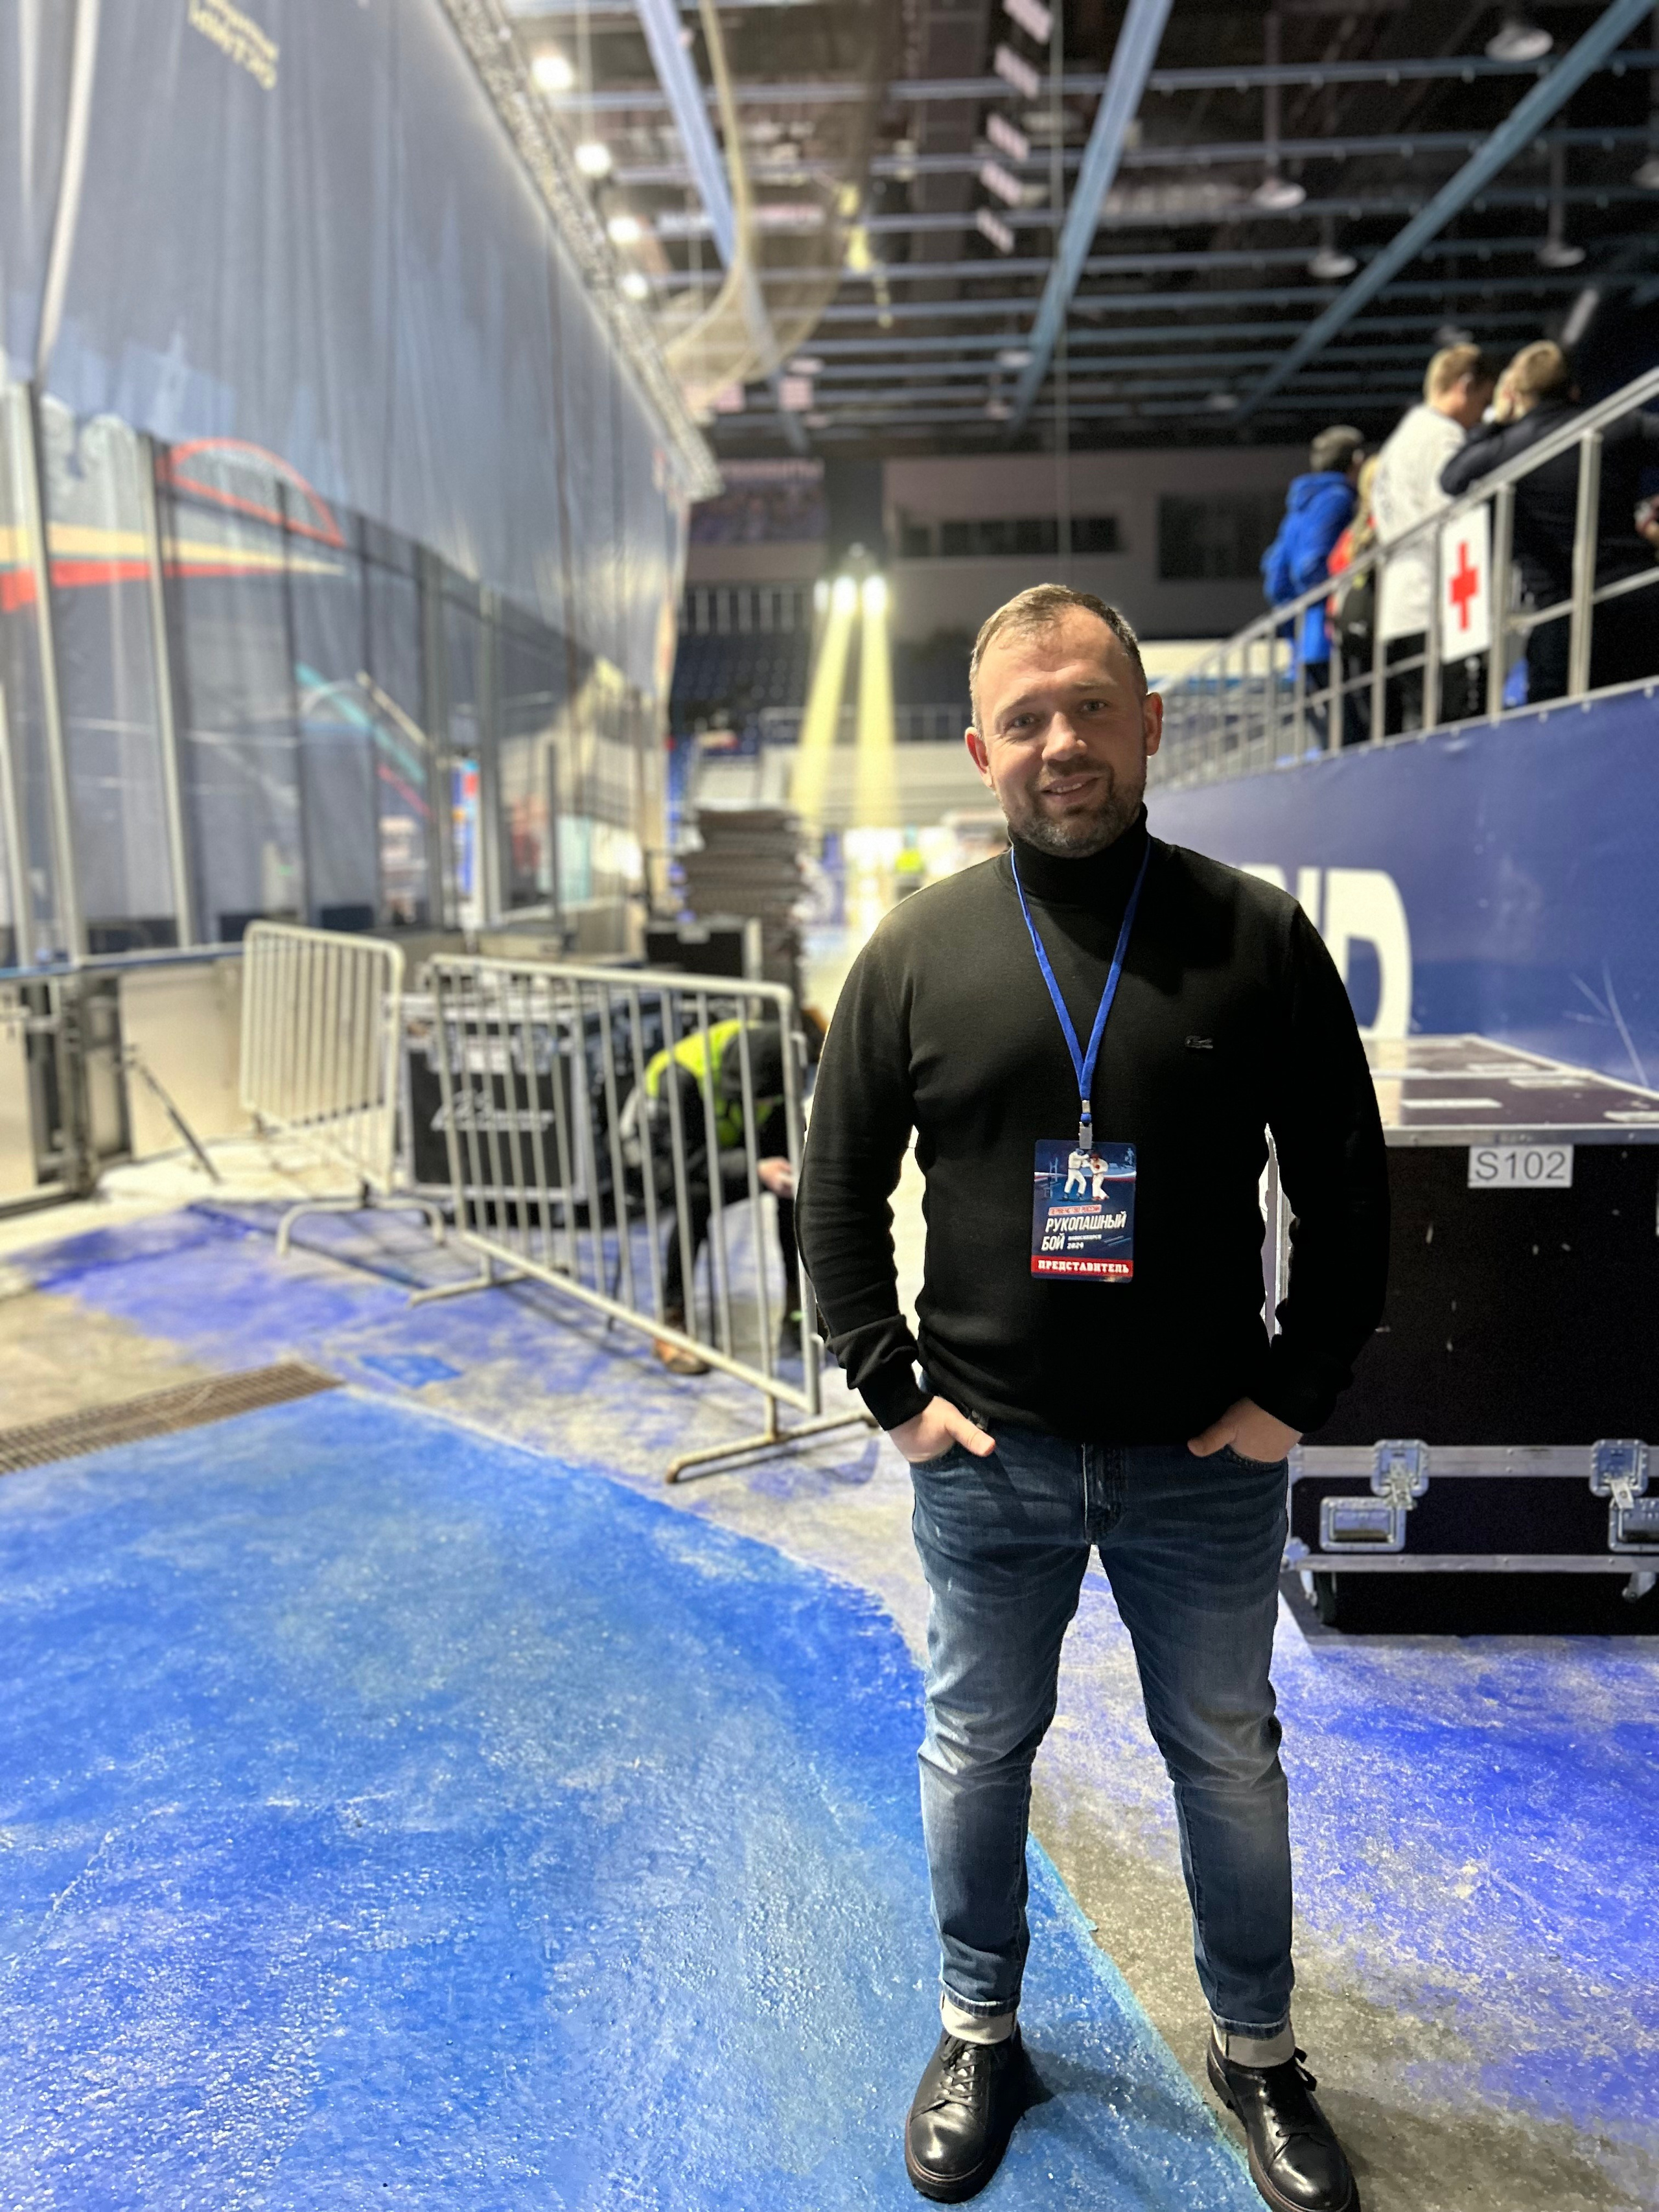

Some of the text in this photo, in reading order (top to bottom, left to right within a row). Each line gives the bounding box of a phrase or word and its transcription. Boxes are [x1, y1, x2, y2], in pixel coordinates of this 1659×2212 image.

[1476, 1151, 1565, 1180] S102
[1045, 1211, 1127, 1233] РУКОПАШНЫЙ
[1041, 1233, 1065, 1252] БОЙ
[1038, 1259, 1129, 1273] ПРЕДСТАВИТЕЛЬ
